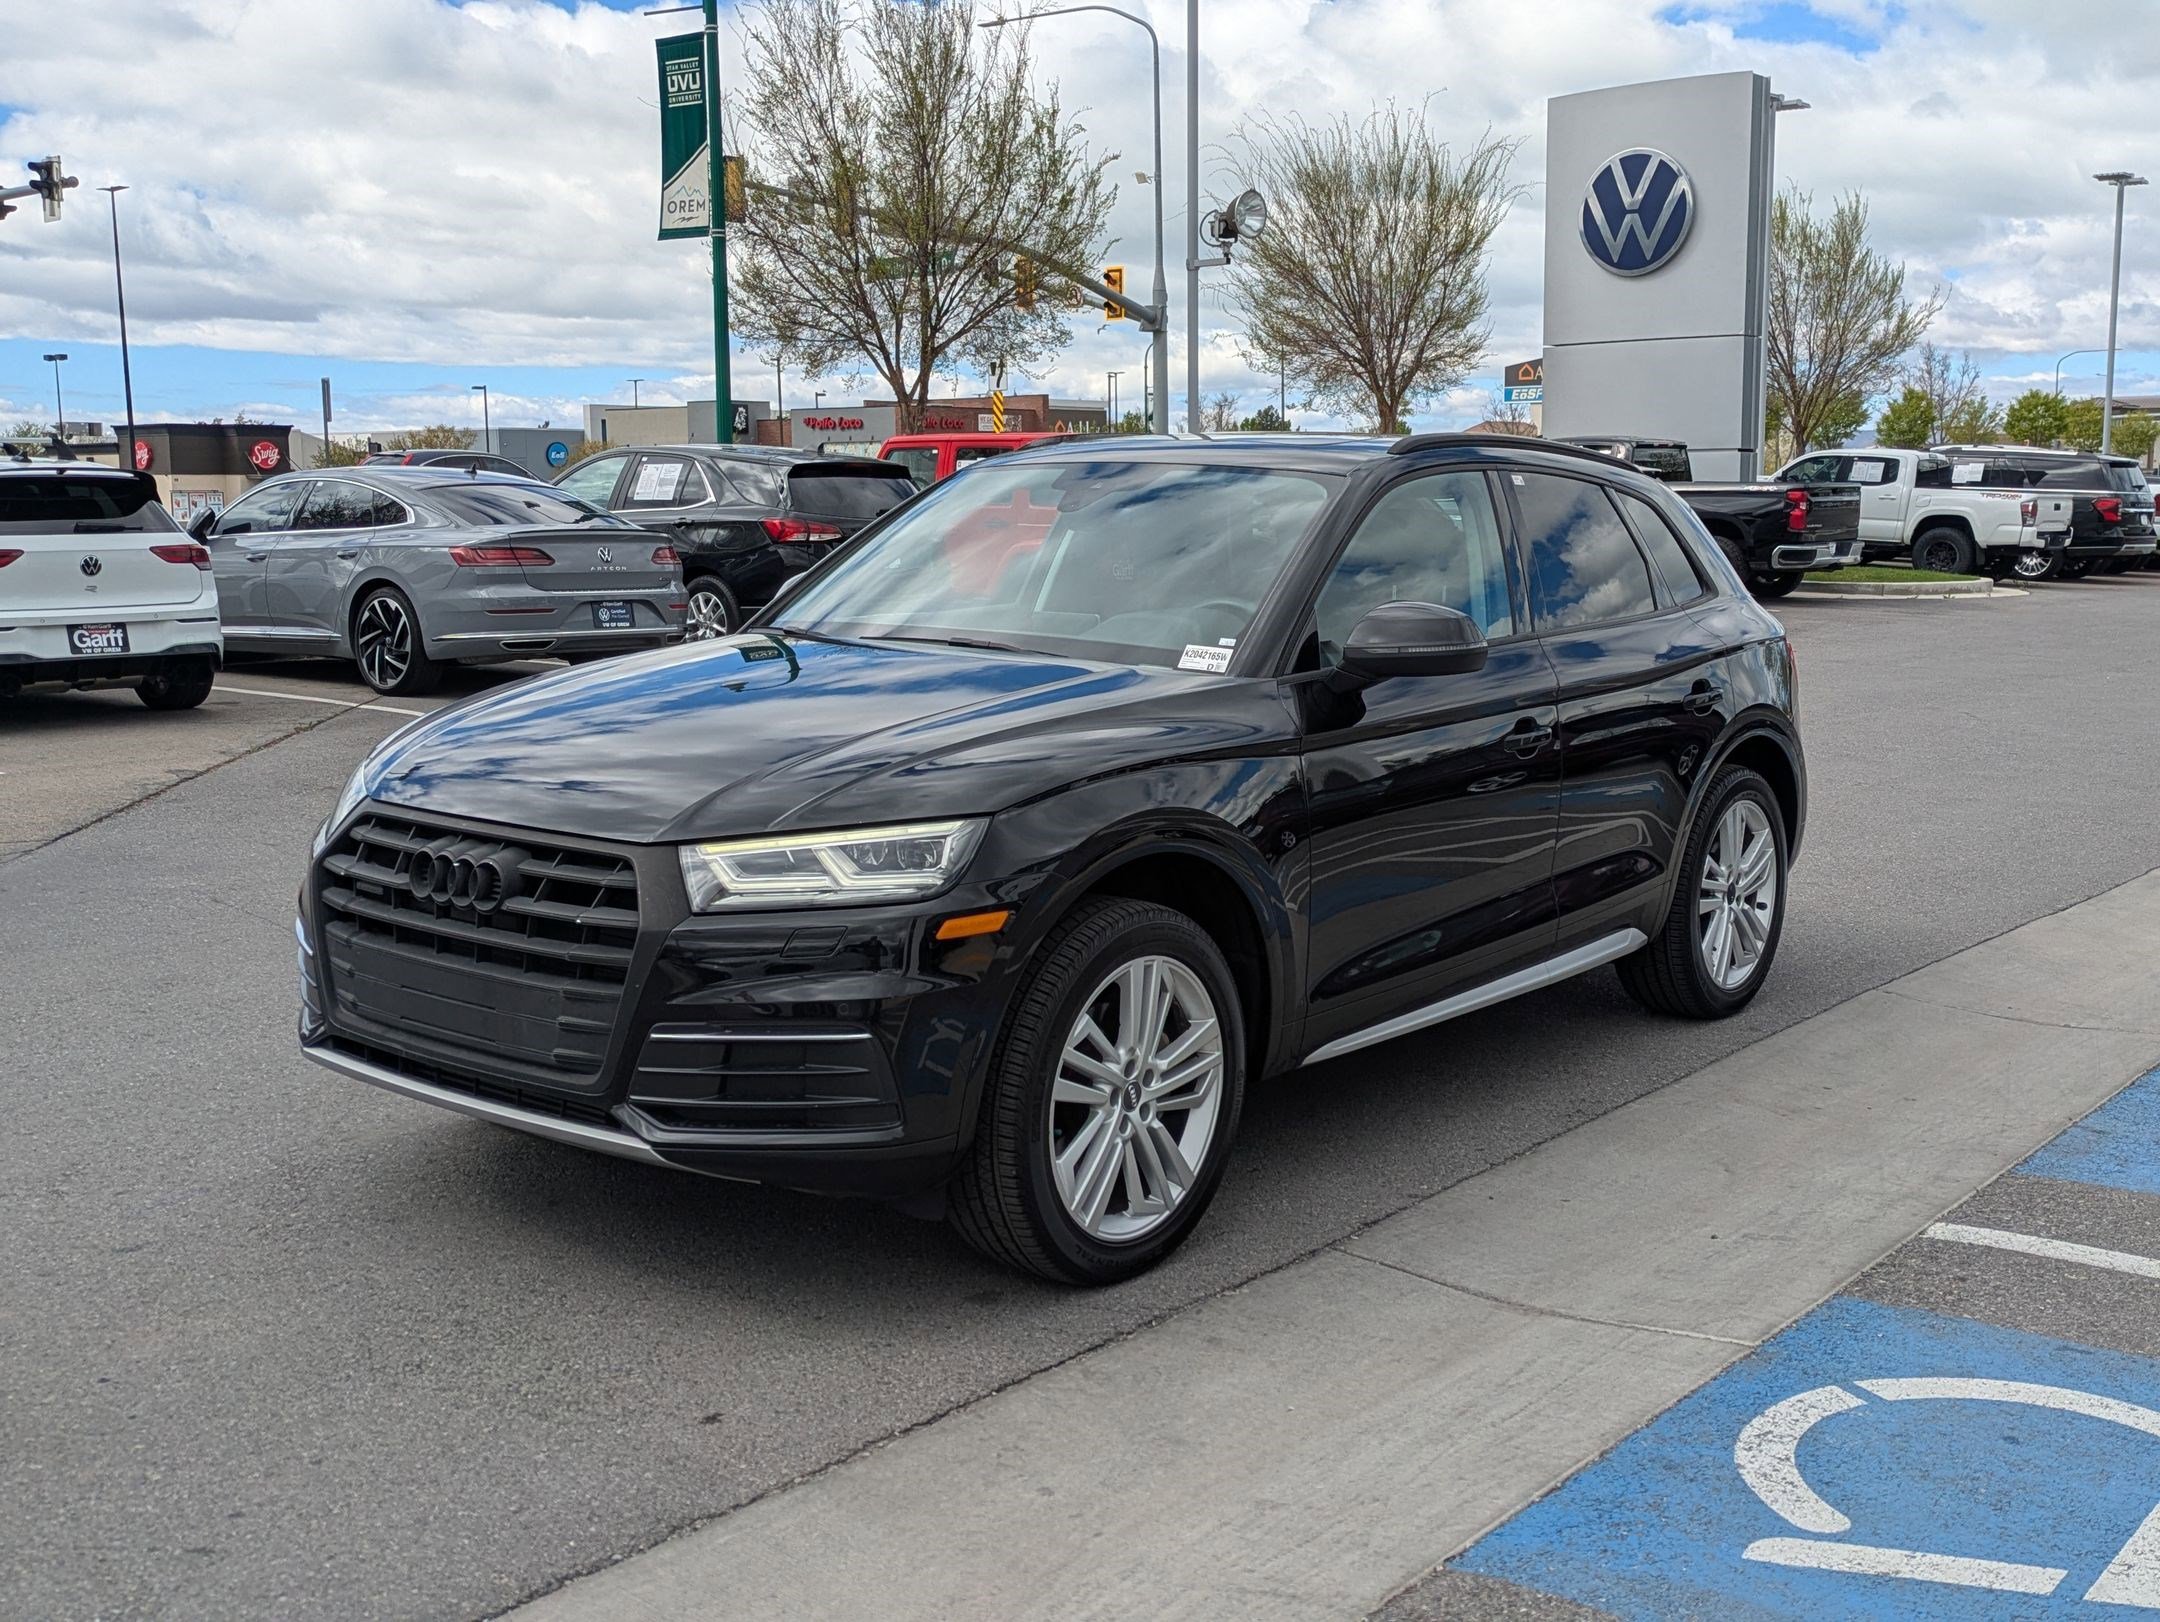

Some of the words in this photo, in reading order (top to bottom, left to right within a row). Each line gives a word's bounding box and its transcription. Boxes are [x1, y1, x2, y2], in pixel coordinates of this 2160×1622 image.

[680, 61, 699, 70] VALLEY
[667, 72, 701, 92] UVU
[668, 93, 701, 103] UNIVERSITY
[667, 198, 706, 214] OREM
[253, 445, 280, 465] Swig
[73, 628, 124, 649] Garff
[1207, 663, 1215, 671] D
